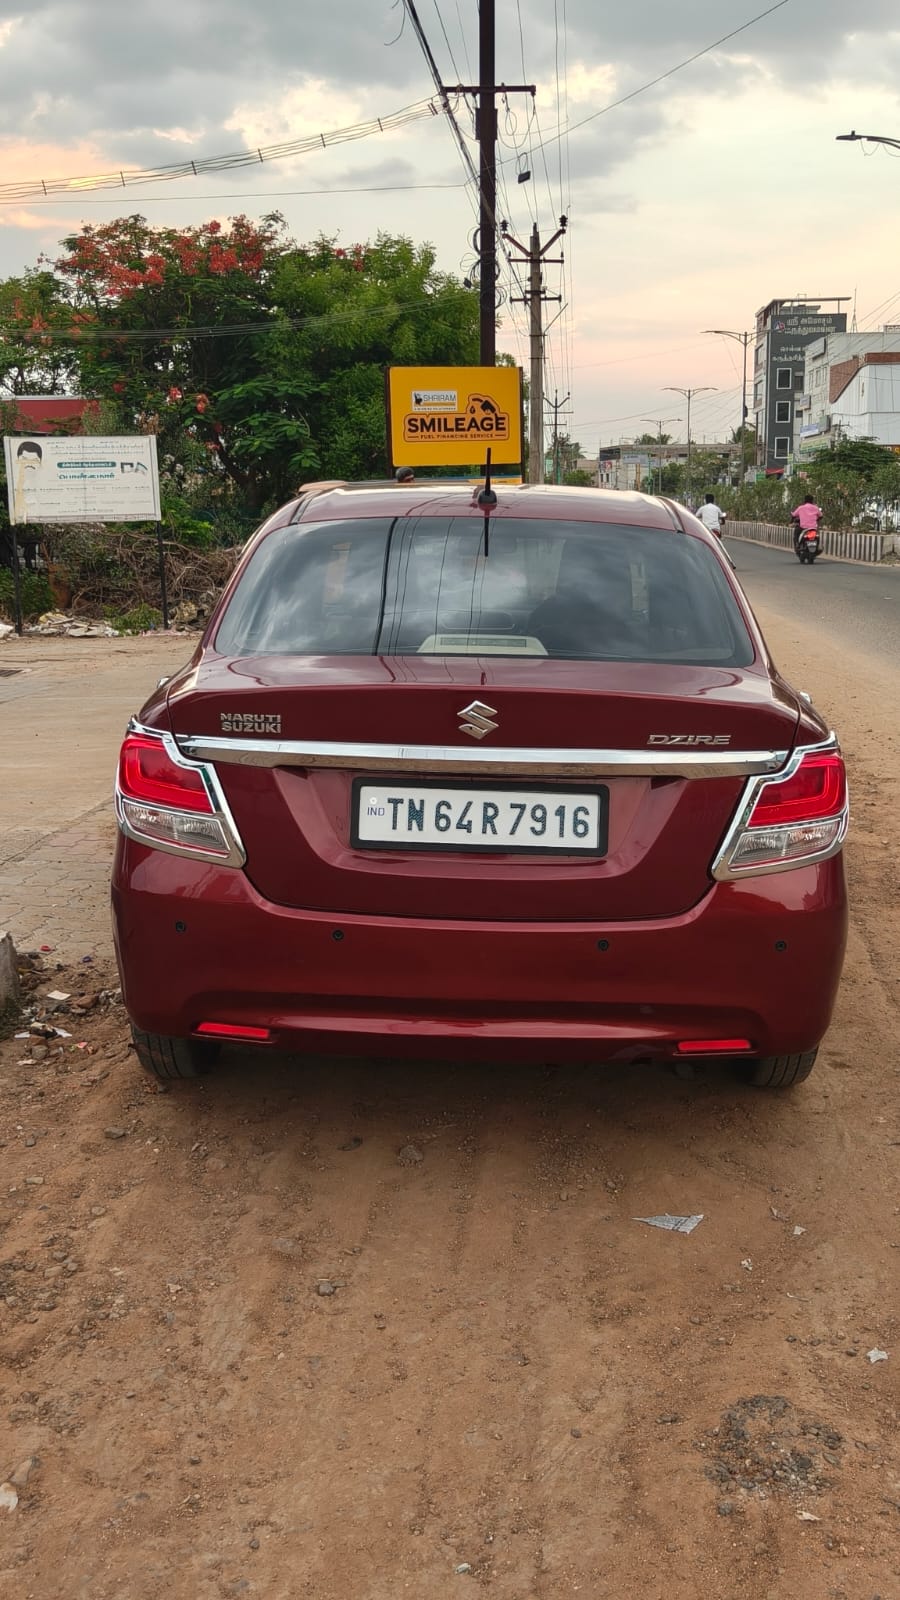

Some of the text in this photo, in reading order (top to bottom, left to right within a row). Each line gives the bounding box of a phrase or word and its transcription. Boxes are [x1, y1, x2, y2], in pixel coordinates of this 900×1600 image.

[423, 394, 456, 402] SHRIRAM
[407, 417, 506, 433] SMILEAGE
[220, 712, 282, 723] MARUTI
[221, 721, 282, 733] SUZUKI
[646, 734, 732, 745] DZIRE
[367, 806, 385, 817] IND
